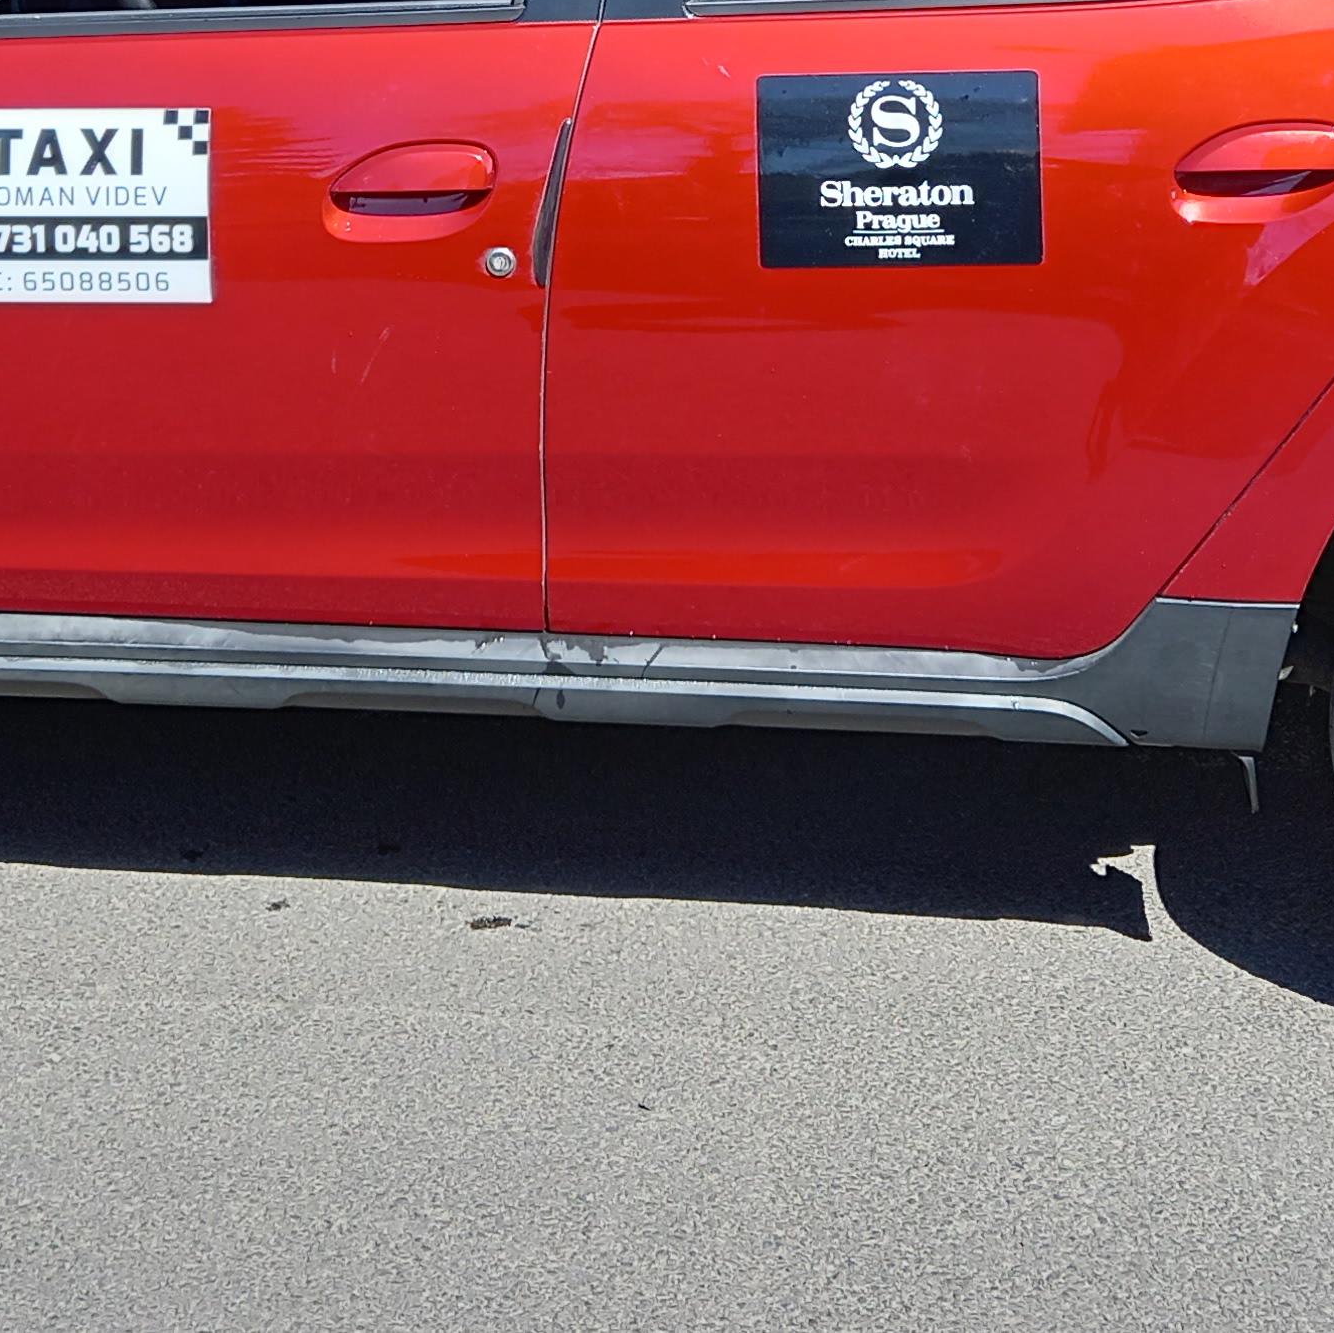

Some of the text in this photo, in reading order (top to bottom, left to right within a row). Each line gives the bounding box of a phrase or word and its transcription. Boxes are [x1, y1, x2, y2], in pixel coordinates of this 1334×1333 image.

[870, 95, 921, 148] S
[86, 185, 168, 207] VIDEV
[820, 180, 975, 207] Sheraton
[855, 210, 941, 233] Prague
[53, 223, 121, 254] 040
[128, 223, 194, 254] 568
[844, 234, 955, 247] CHARLES SQUARE
[878, 247, 921, 259] HOTEL
[22, 271, 171, 292] 65088506
